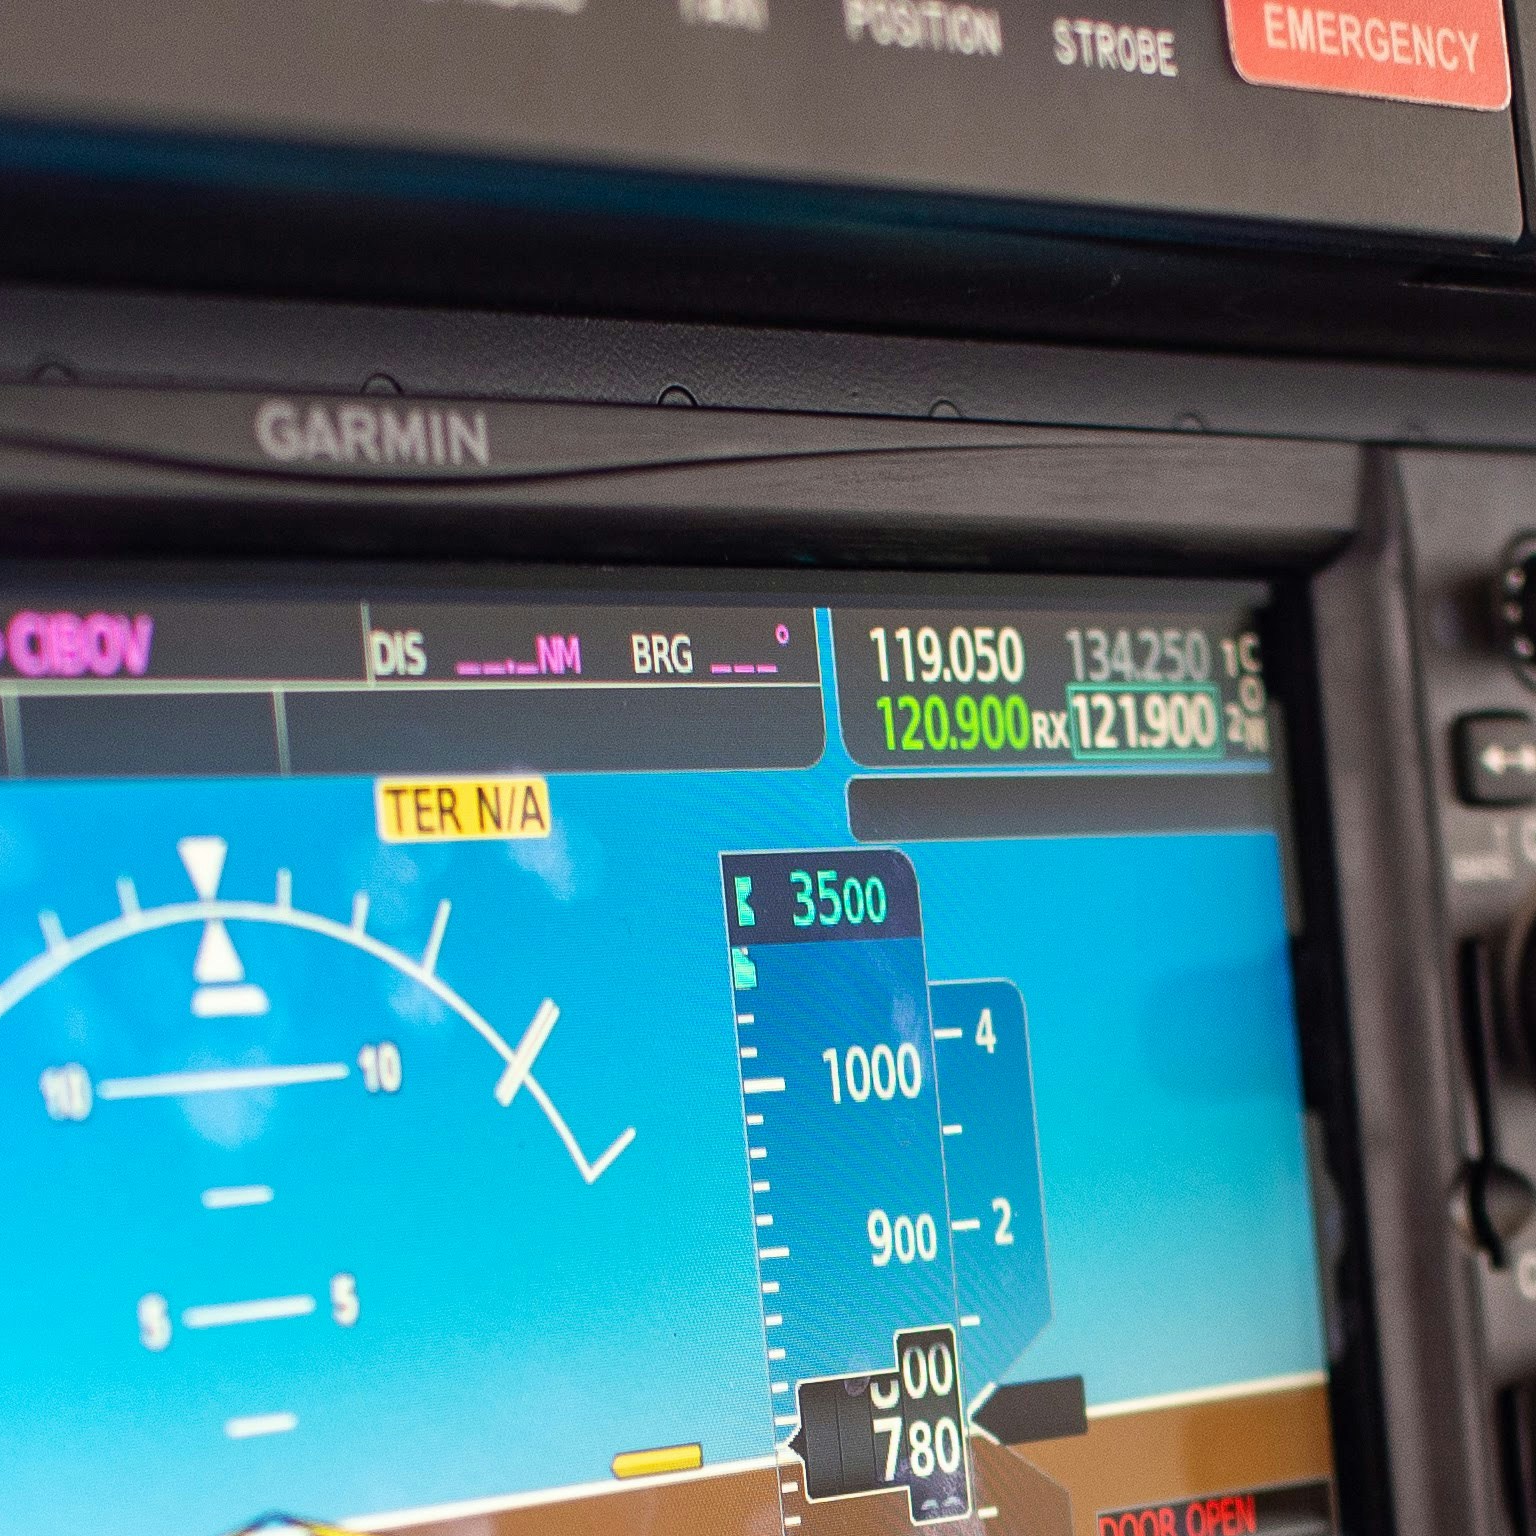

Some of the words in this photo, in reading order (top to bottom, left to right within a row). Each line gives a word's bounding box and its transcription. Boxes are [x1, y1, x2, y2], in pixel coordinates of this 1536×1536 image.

[846, 0, 1001, 56] POSITION
[1053, 17, 1178, 77] STROBE
[1266, 10, 1480, 74] EMERGENCY
[255, 402, 489, 465] GARMIN
[369, 630, 427, 676] DIS
[631, 634, 693, 674] BRG
[869, 627, 1025, 684] 119.050
[1066, 629, 1213, 683] 134.250
[876, 694, 1030, 750] 120.900
[1032, 712, 1070, 749] RX
[1072, 694, 1216, 748] 121.900
[384, 786, 462, 834] TER
[477, 785, 546, 831] N/A
[790, 870, 887, 926] 3500
[975, 1009, 996, 1053] 4
[358, 1042, 402, 1092] 10
[822, 1043, 922, 1104] 1000
[868, 1209, 937, 1266] 900
[992, 1198, 1013, 1244] 2
[330, 1273, 359, 1328] 5
[873, 1416, 960, 1481] 780
